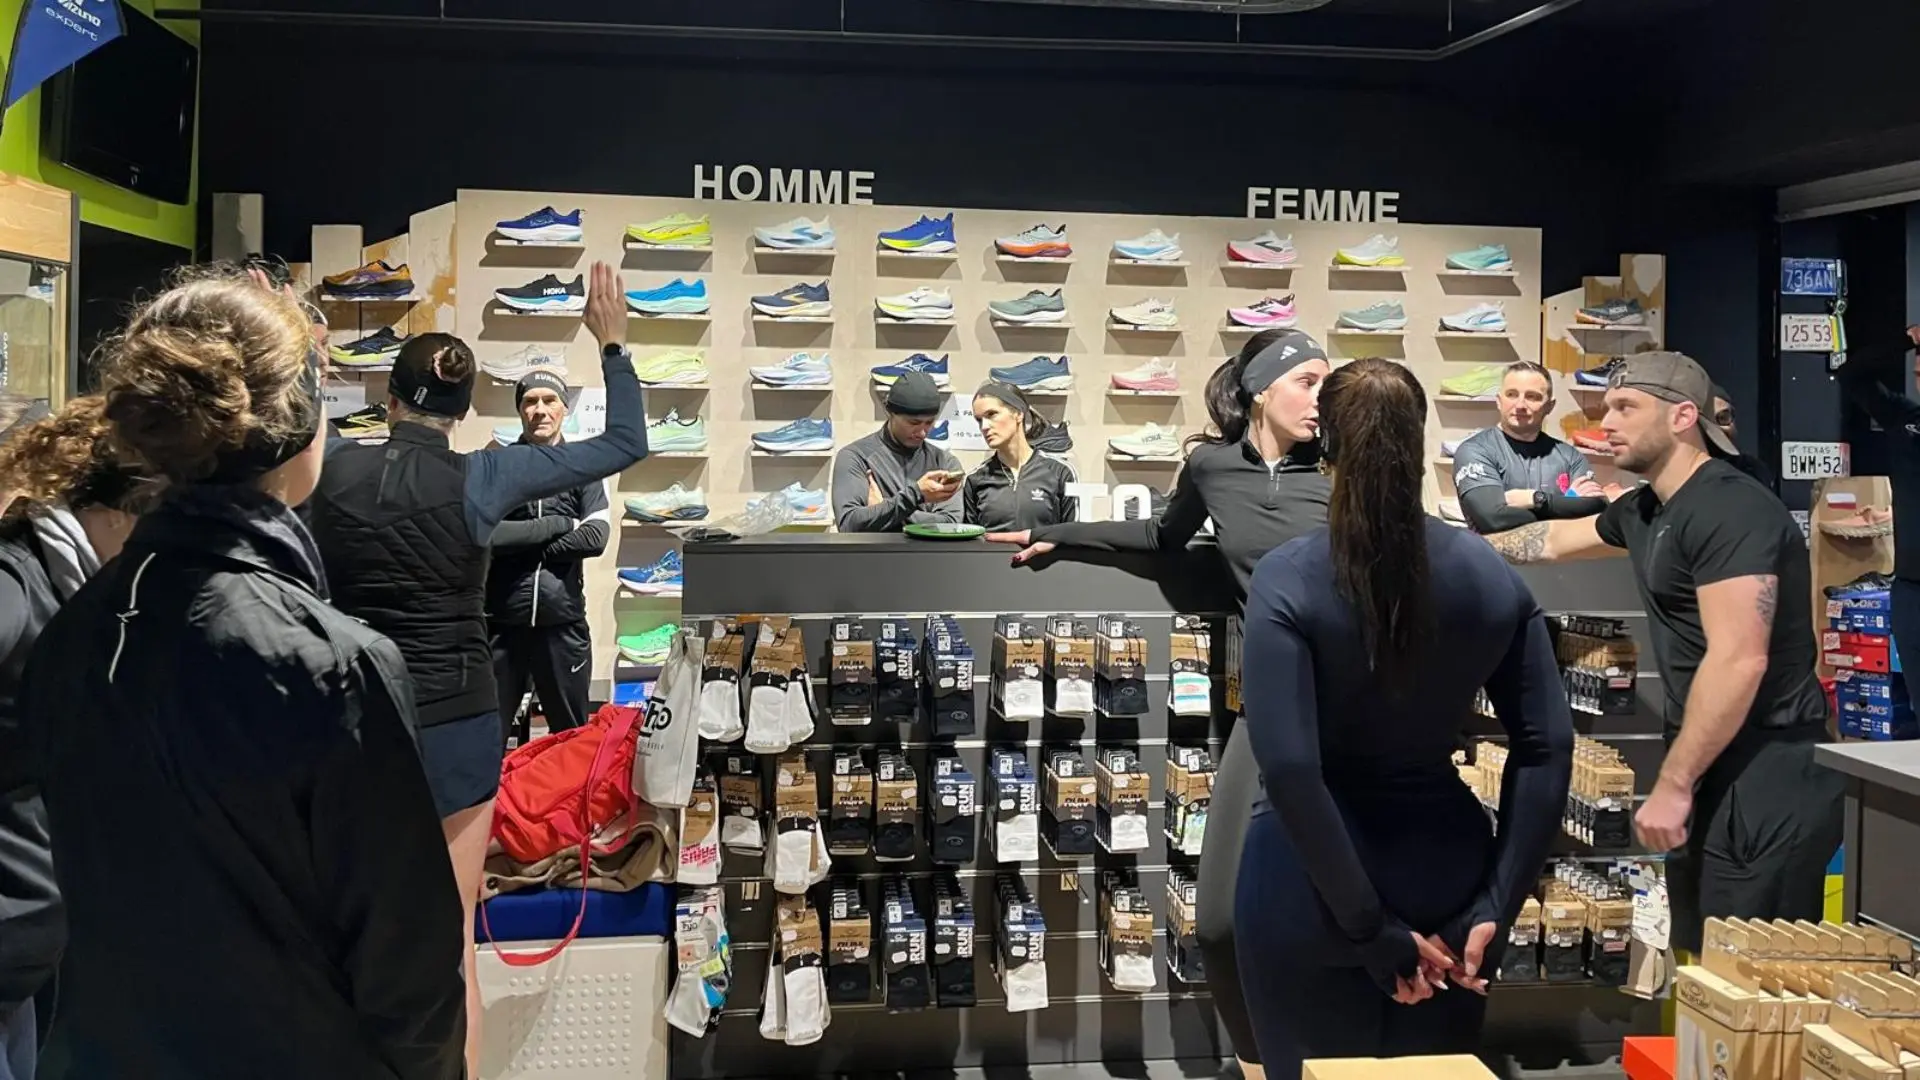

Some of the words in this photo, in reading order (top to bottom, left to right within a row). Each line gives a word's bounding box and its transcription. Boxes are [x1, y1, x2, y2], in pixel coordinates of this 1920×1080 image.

[45, 7, 98, 41] expert
[694, 164, 875, 205] HOMME
[1247, 187, 1399, 223] FEMME
[543, 286, 567, 297] HOKA
[526, 356, 550, 367] HOKA
[1802, 446, 1831, 454] TEXAS
[898, 649, 908, 677] RUN
[957, 660, 968, 689] RUN
[958, 784, 969, 815] RUN
[1020, 783, 1031, 812] RUN
[909, 932, 920, 962] RUN
[957, 927, 968, 956] RUN
[1028, 932, 1038, 960] RUN
